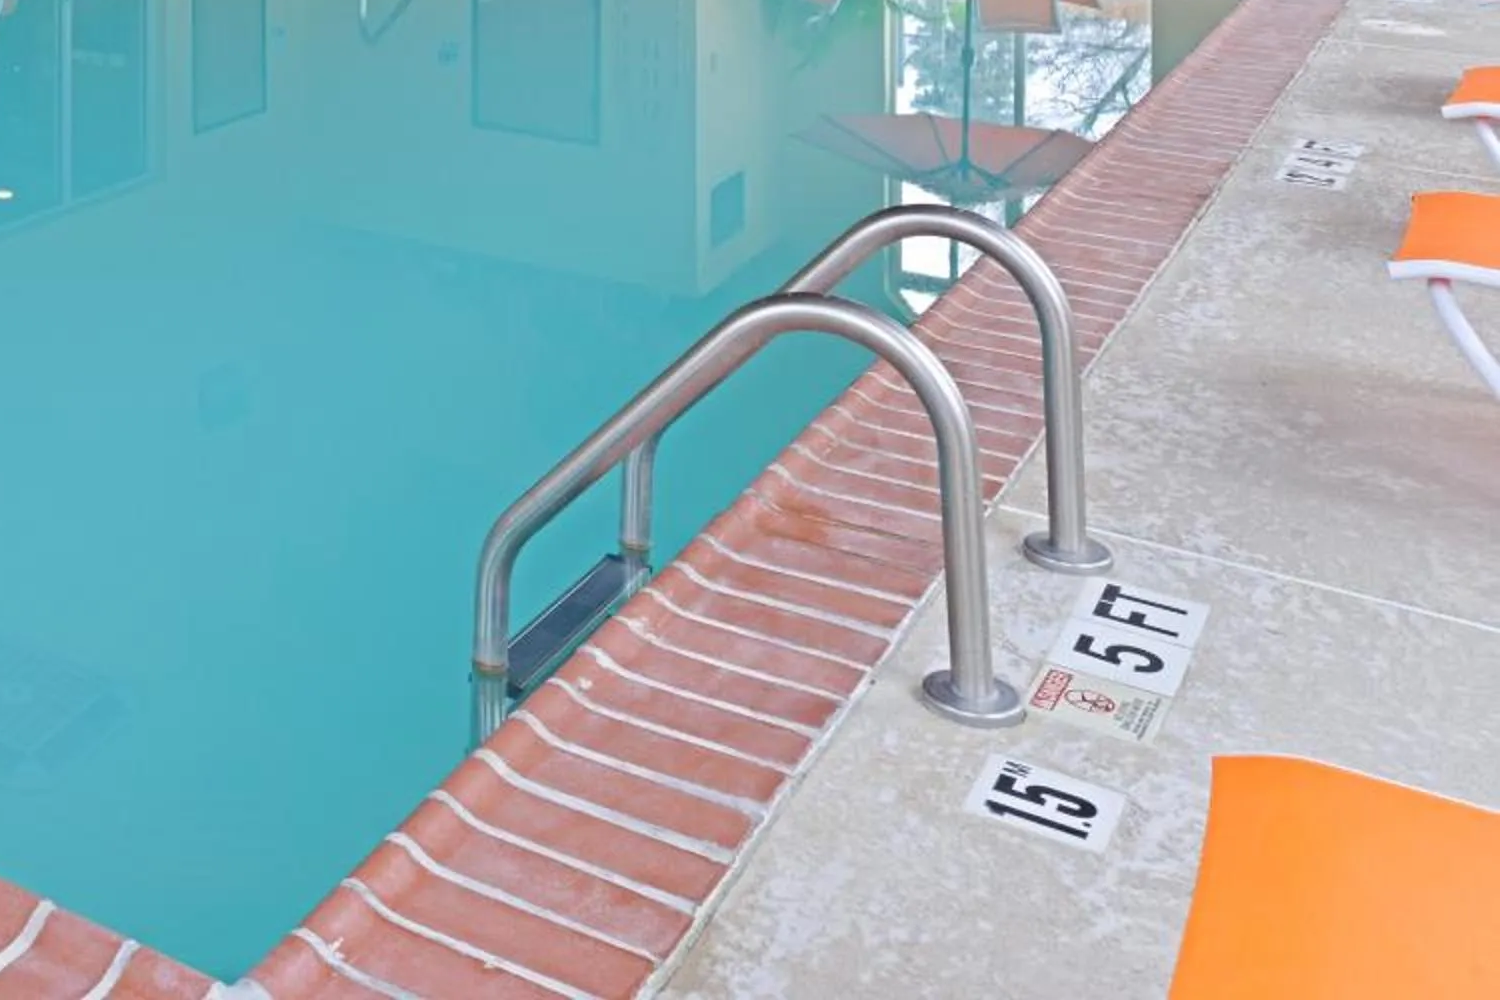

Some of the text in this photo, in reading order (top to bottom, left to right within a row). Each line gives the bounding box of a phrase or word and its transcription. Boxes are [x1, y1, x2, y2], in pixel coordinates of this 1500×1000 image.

[1092, 583, 1188, 638] FT
[1073, 634, 1164, 673] 5
[984, 773, 1098, 840] 1.5
